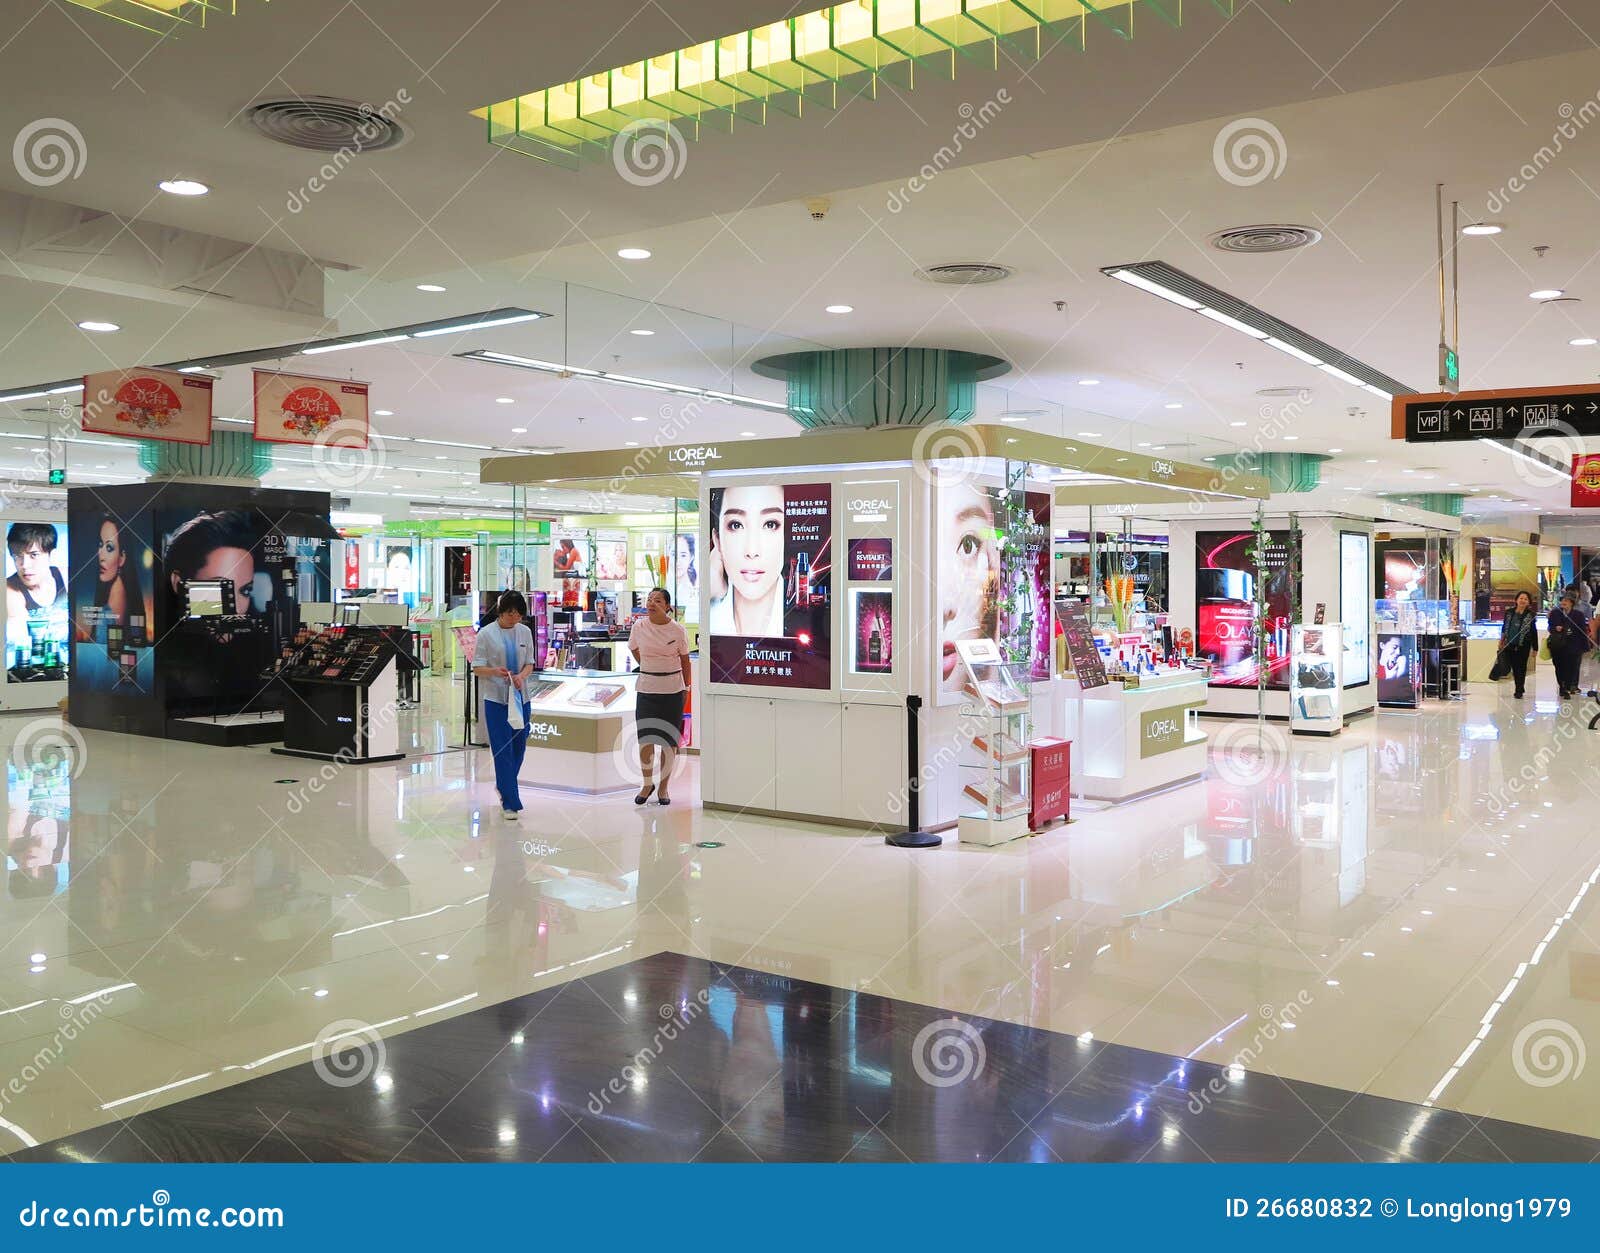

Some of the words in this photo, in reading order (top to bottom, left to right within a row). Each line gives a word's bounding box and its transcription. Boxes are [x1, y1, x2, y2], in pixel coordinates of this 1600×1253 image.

[1420, 416, 1438, 428] VIP
[264, 535, 278, 546] 3D
[745, 649, 793, 662] REVITALIFT
